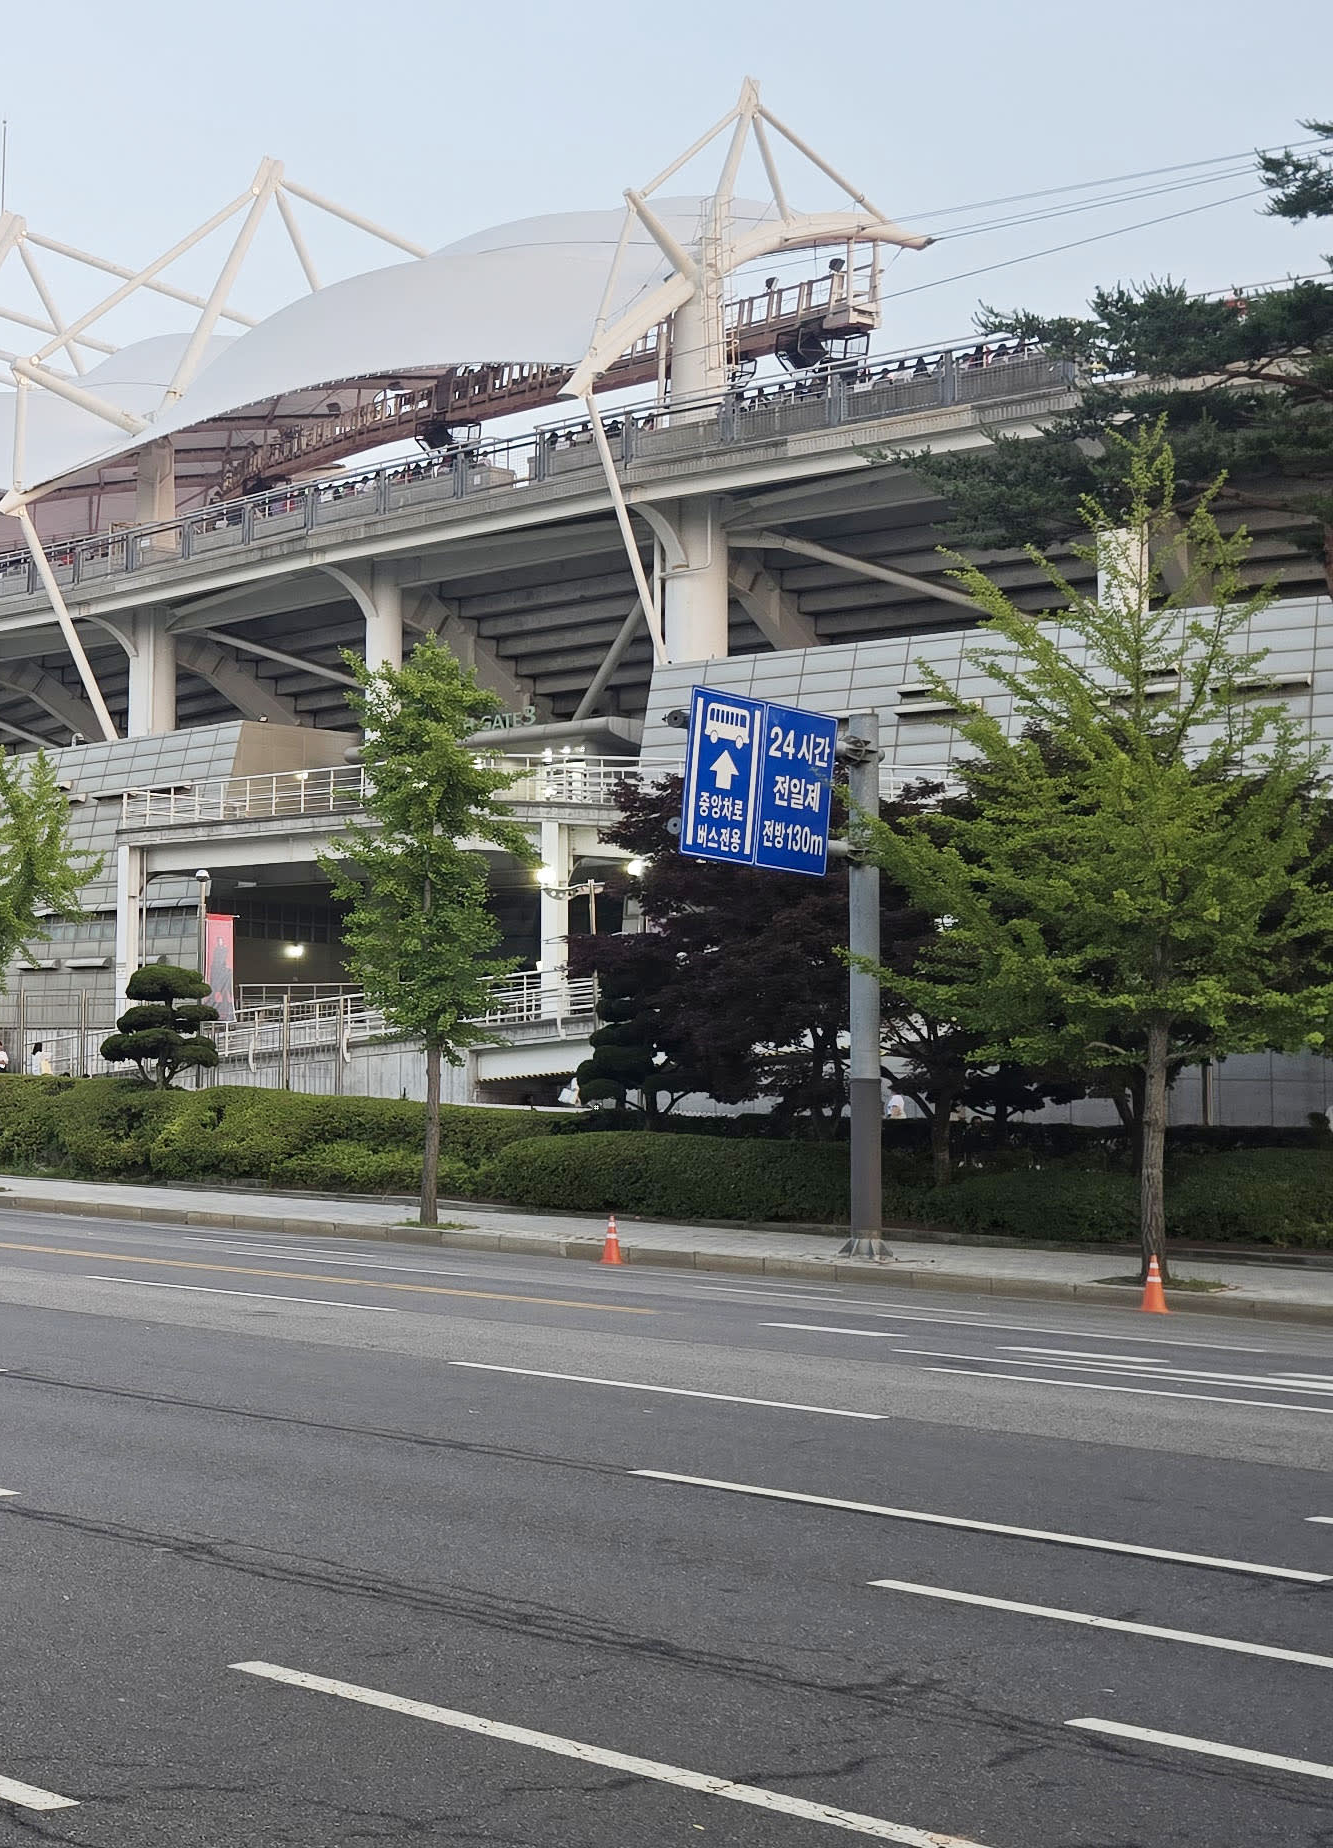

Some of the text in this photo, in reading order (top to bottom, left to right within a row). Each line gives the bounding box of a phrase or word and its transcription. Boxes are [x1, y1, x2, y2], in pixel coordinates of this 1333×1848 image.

[480, 711, 523, 731] GATE
[768, 726, 831, 768] 24 시간
[698, 791, 744, 822] 중앙차로
[773, 775, 821, 813] 전일제
[696, 823, 742, 853] 버스전용
